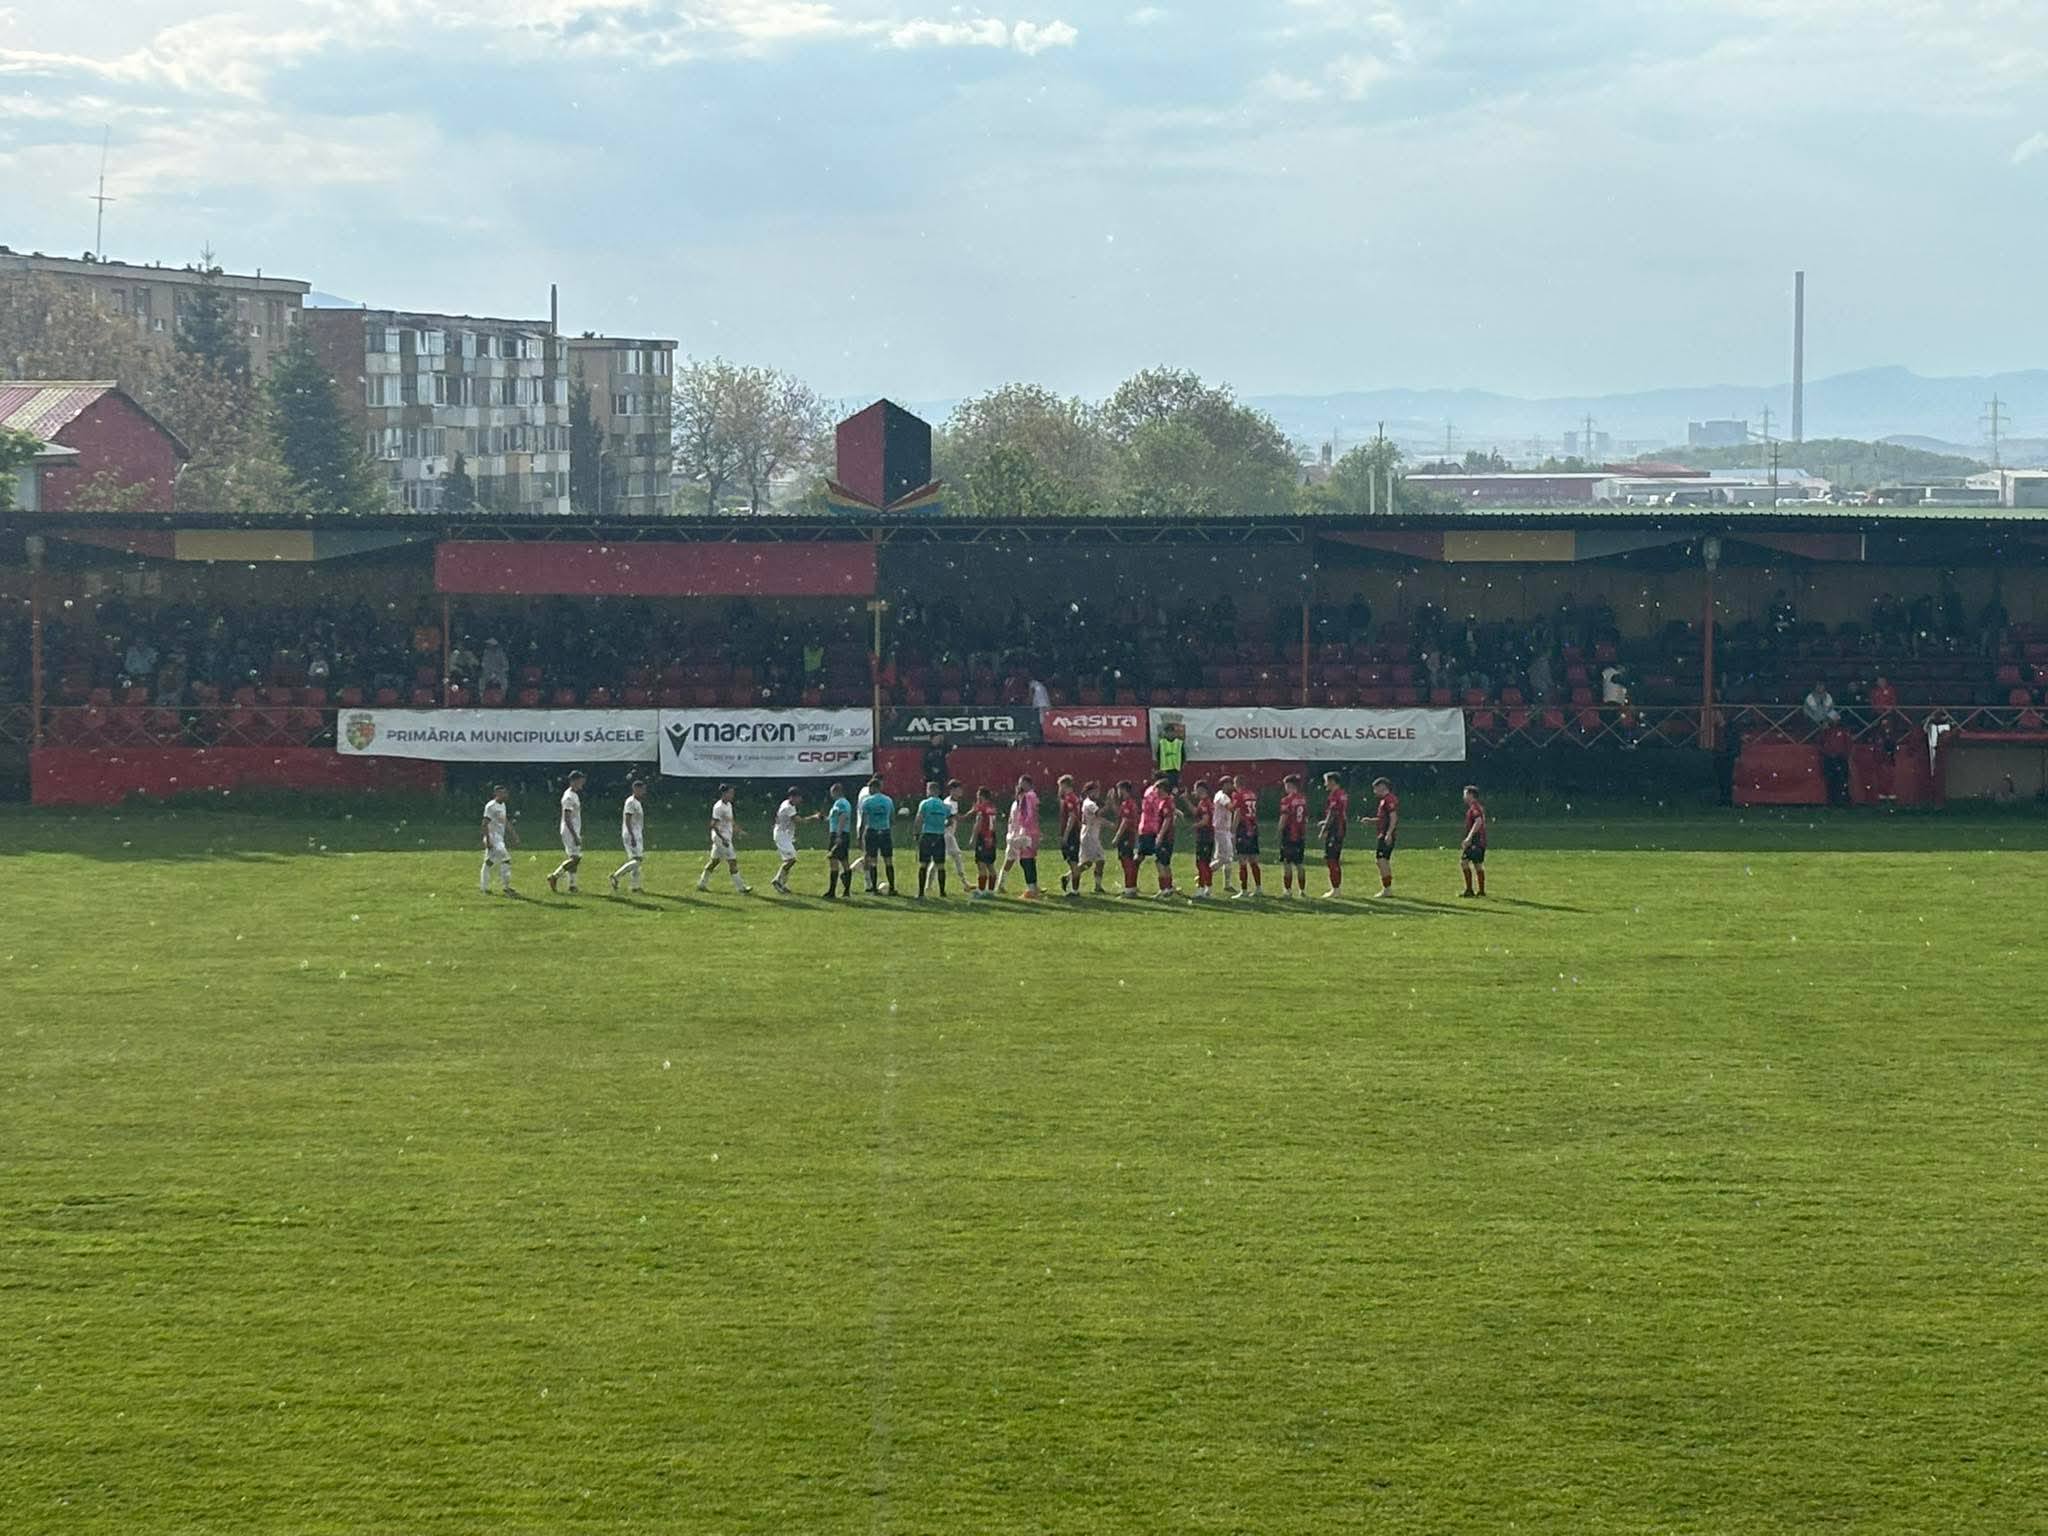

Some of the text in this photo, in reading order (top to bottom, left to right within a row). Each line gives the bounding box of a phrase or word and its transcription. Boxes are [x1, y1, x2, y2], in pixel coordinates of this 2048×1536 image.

[470, 730, 580, 743] MUNICIPIULUI
[583, 727, 645, 742] SĂCELE
[693, 722, 795, 743] macron
[1215, 724, 1416, 740] CONSILIUL LOCAL SĂCELE
